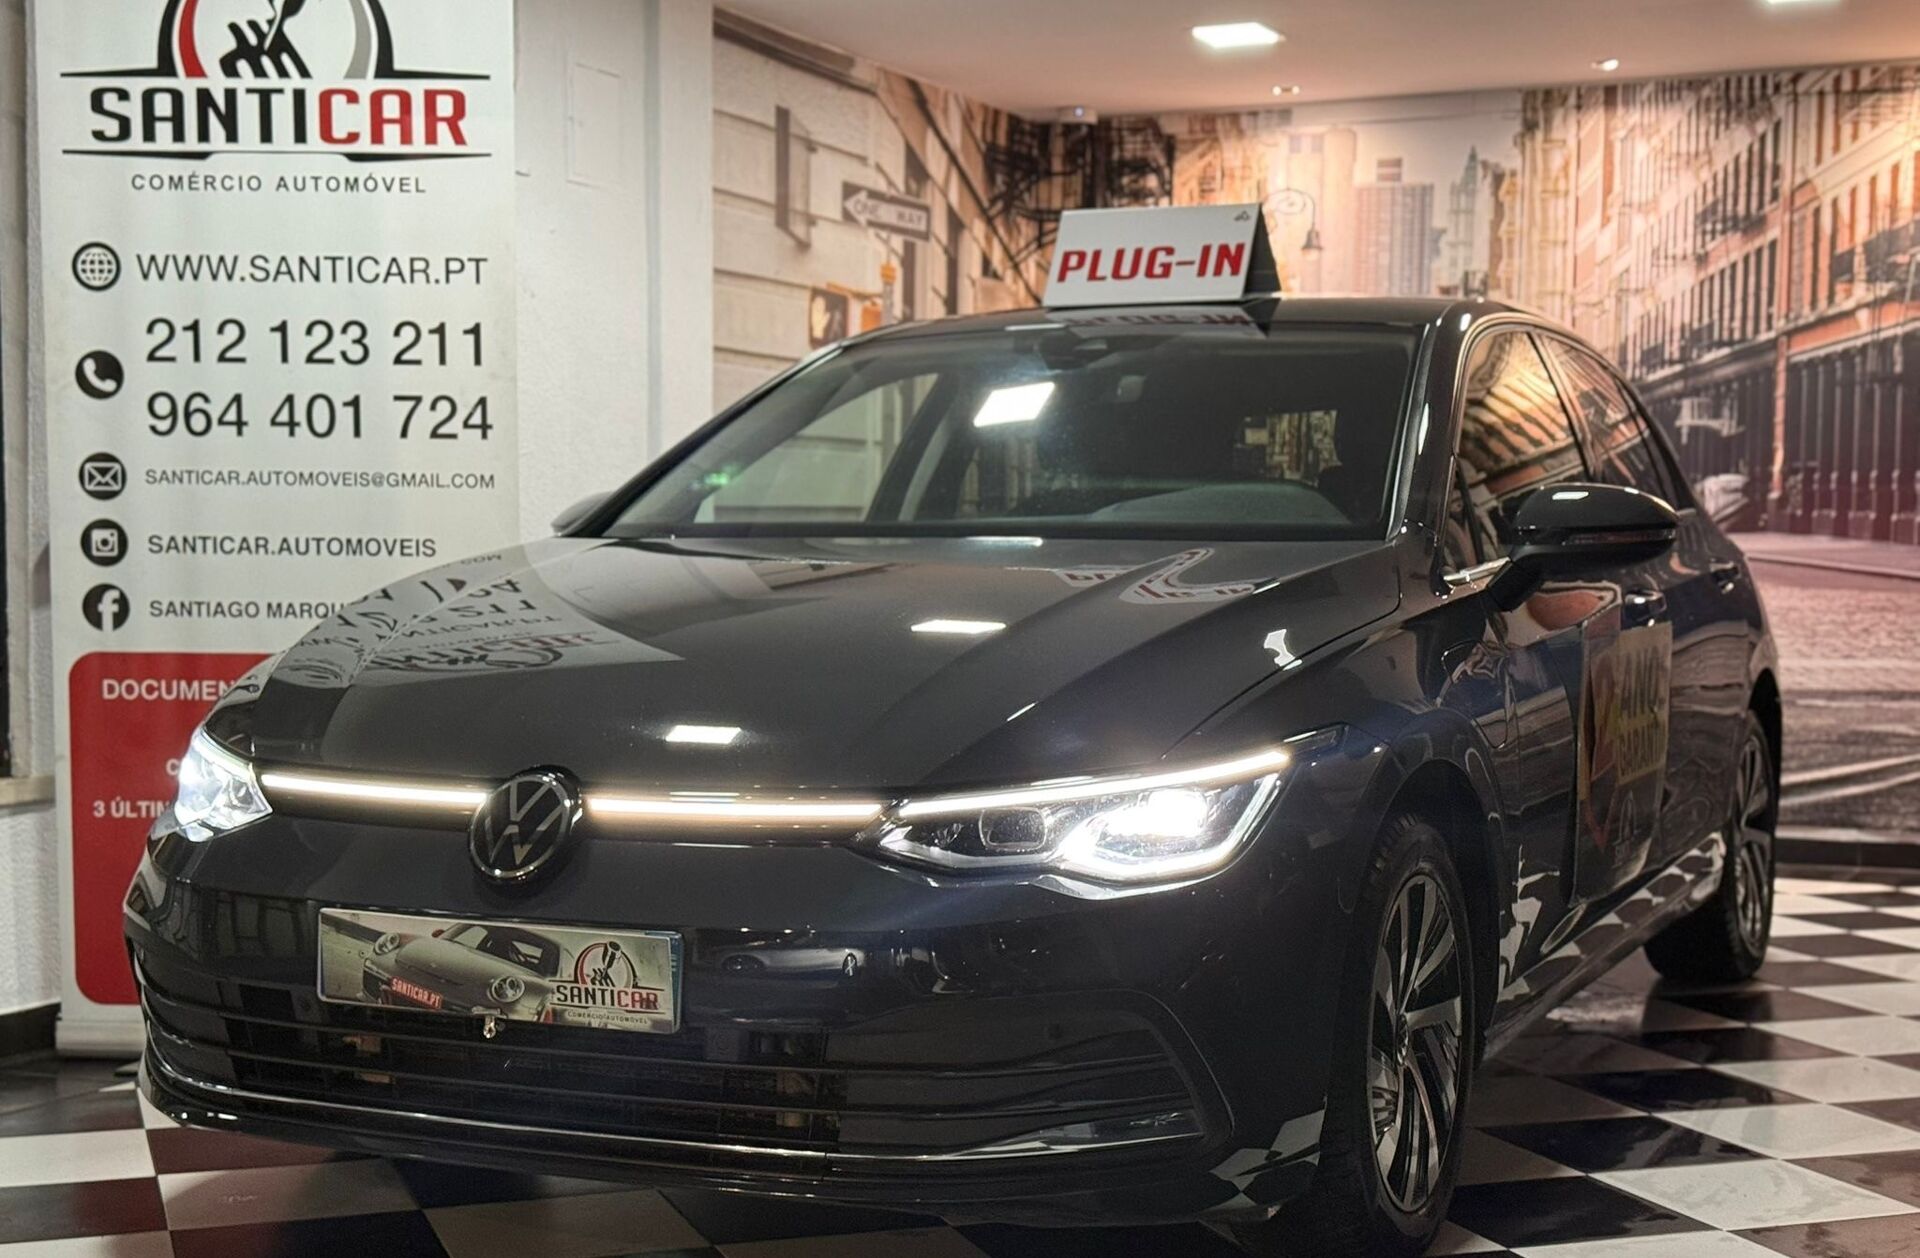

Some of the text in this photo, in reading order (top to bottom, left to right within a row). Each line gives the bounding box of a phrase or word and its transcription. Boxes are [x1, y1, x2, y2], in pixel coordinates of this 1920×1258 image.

[90, 86, 468, 146] SANTICAR
[131, 171, 426, 194] COMÉRCIO AUTOMÓVEL
[135, 253, 489, 285] WWW.SANTICAR.PT
[1057, 242, 1246, 283] PLUG-IN
[146, 317, 484, 367] 212 123 211
[147, 391, 494, 441] 964 401 724
[144, 468, 496, 490] SANTICAR.AUTOMOVEIS@GMAIL.COM
[147, 534, 437, 558] SANTICAR.AUTOMOVEIS
[149, 600, 260, 619] SANTIAGO
[93, 800, 106, 818] 3
[556, 984, 660, 1011] SANTICAR
